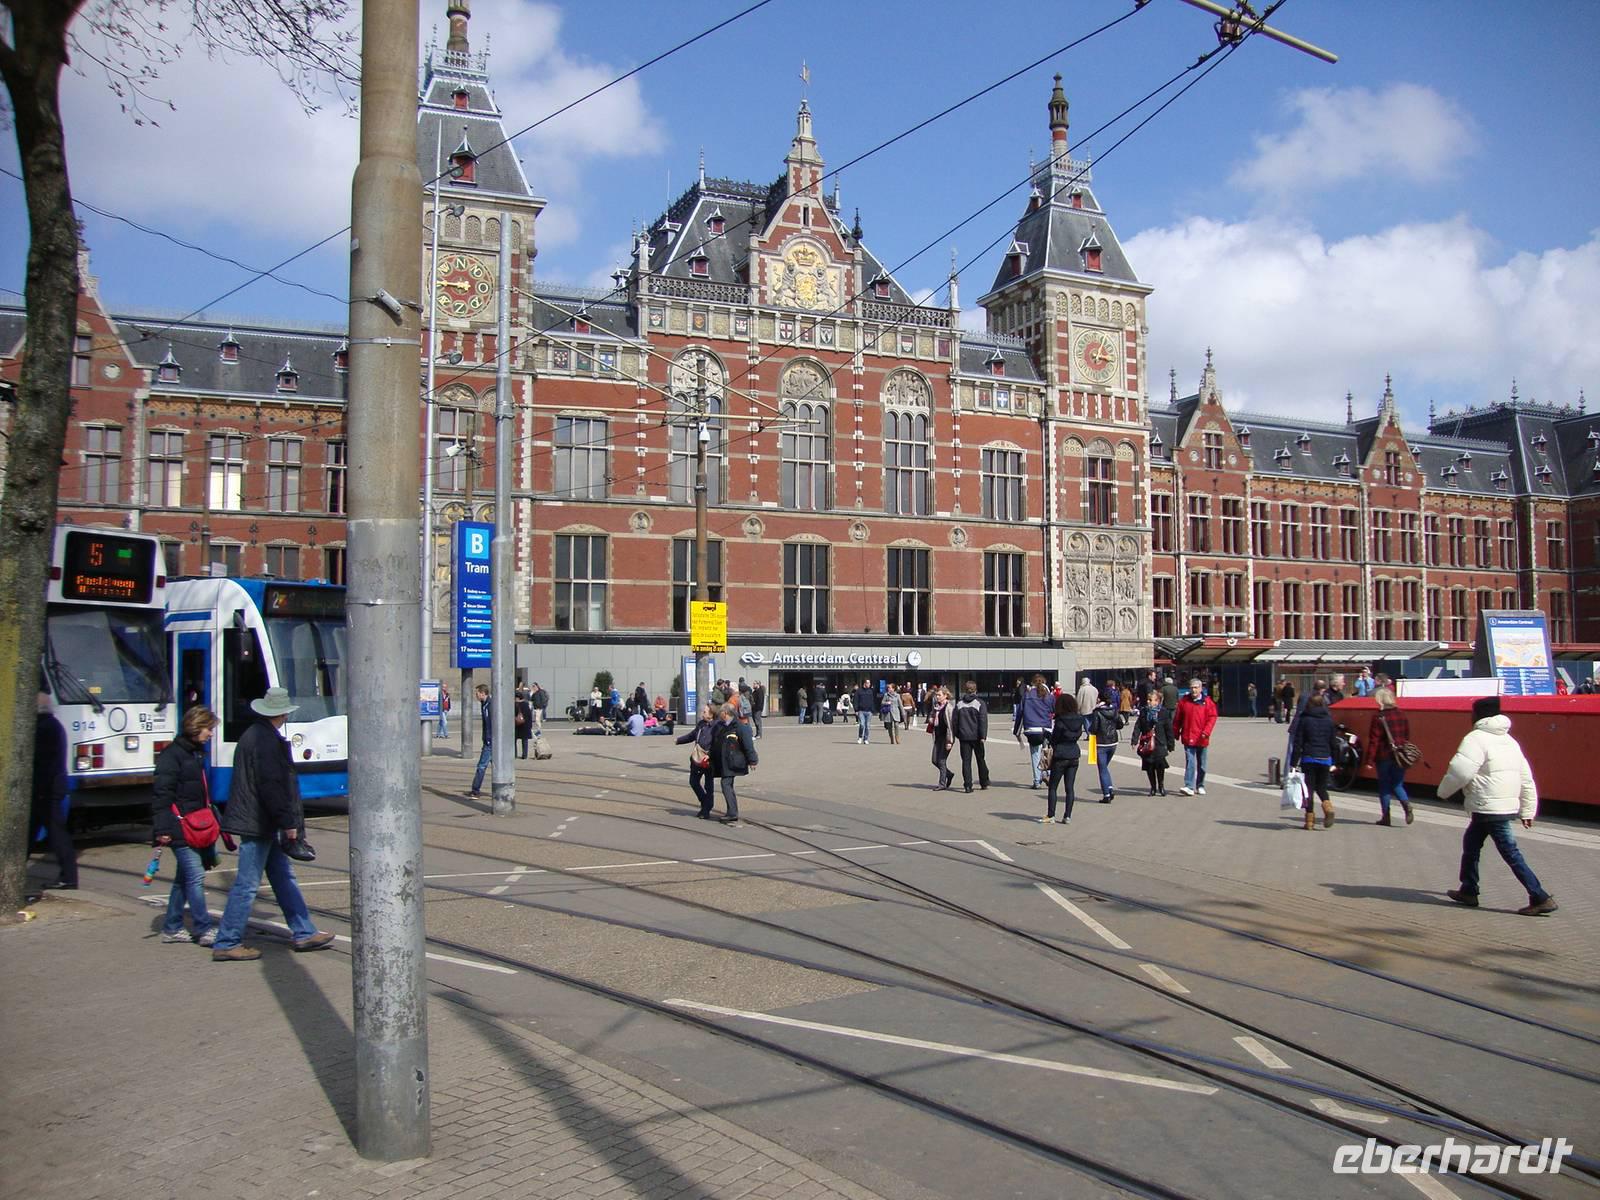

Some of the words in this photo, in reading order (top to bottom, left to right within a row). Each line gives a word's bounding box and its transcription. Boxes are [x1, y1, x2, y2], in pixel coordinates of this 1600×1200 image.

[471, 533, 484, 554] B
[89, 543, 104, 567] 5
[465, 561, 490, 574] Tram
[272, 591, 280, 609] 2
[773, 652, 845, 664] Amsterdam
[849, 652, 900, 664] Centraal
[72, 720, 97, 732] 914
